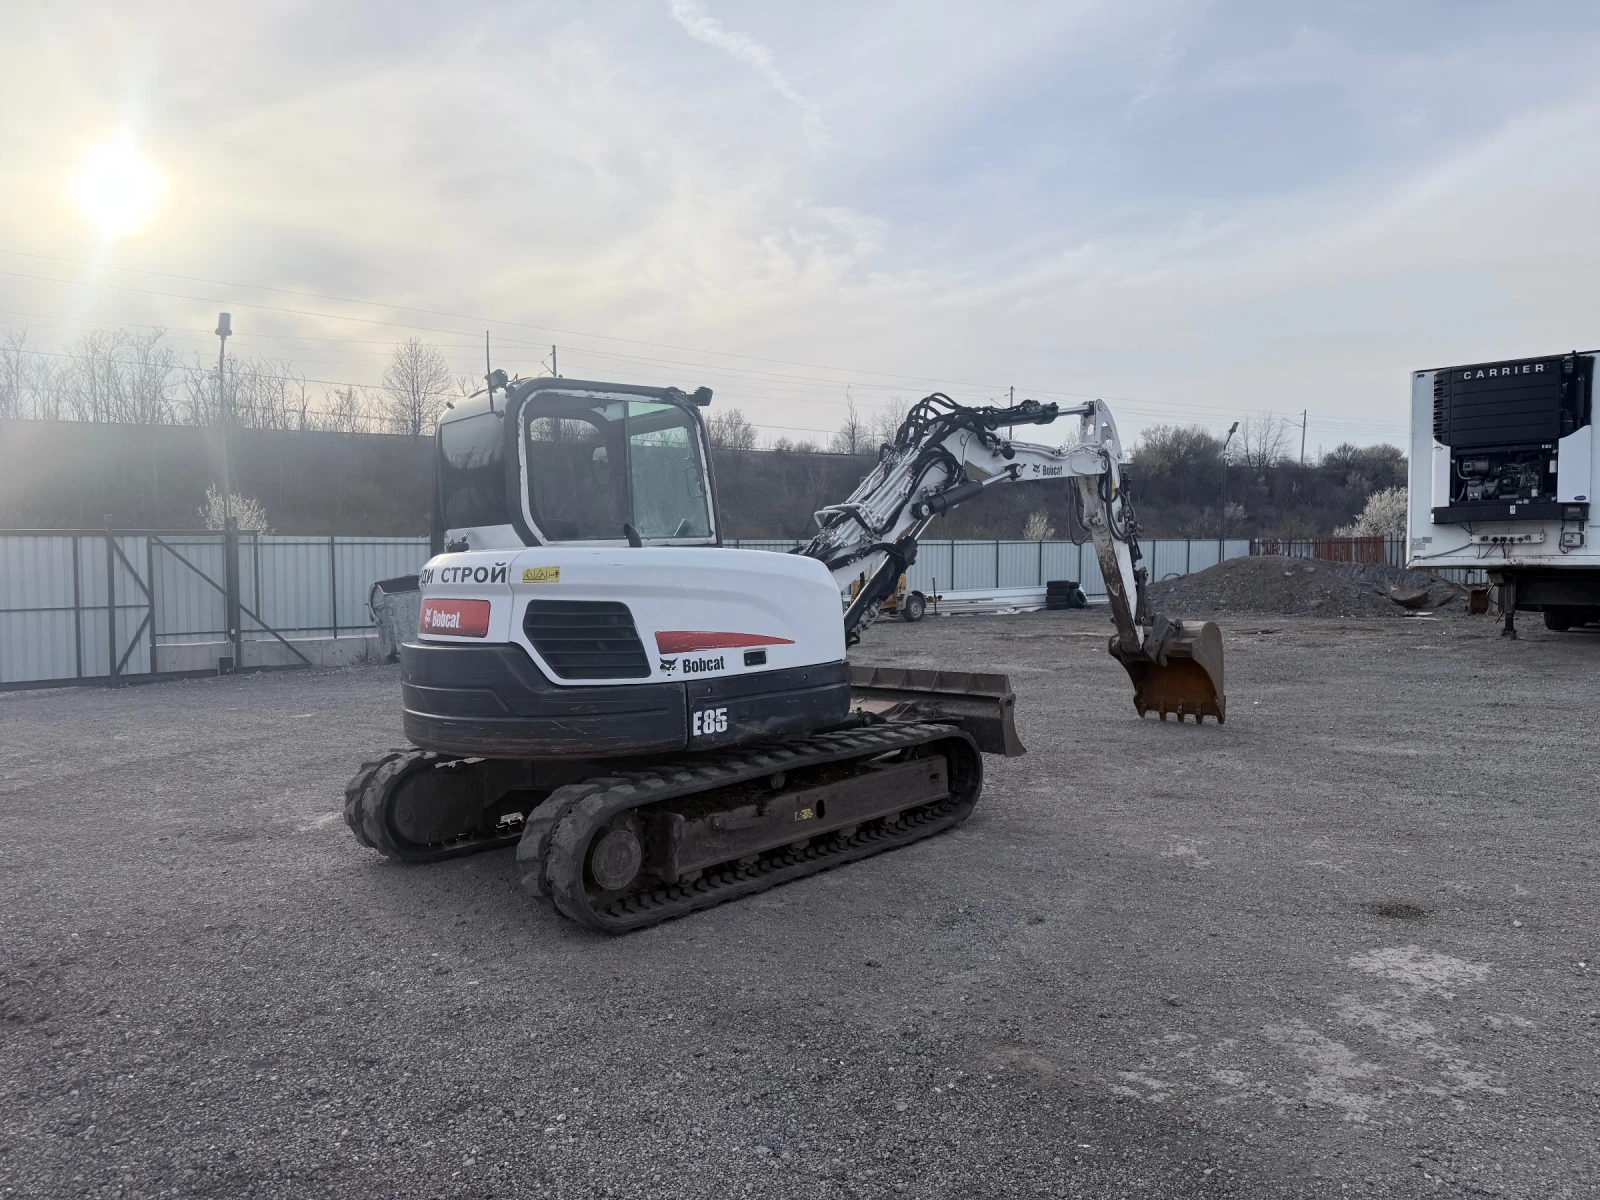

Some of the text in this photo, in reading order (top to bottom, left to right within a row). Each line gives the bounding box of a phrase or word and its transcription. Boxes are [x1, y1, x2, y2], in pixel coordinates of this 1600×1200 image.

[1463, 363, 1545, 380] CARRIER
[1042, 464, 1063, 476] Bobcat
[440, 562, 507, 584] СТРОЙ
[431, 609, 461, 629] Bobcat
[682, 655, 725, 674] Bobcat
[692, 707, 728, 737] E85
